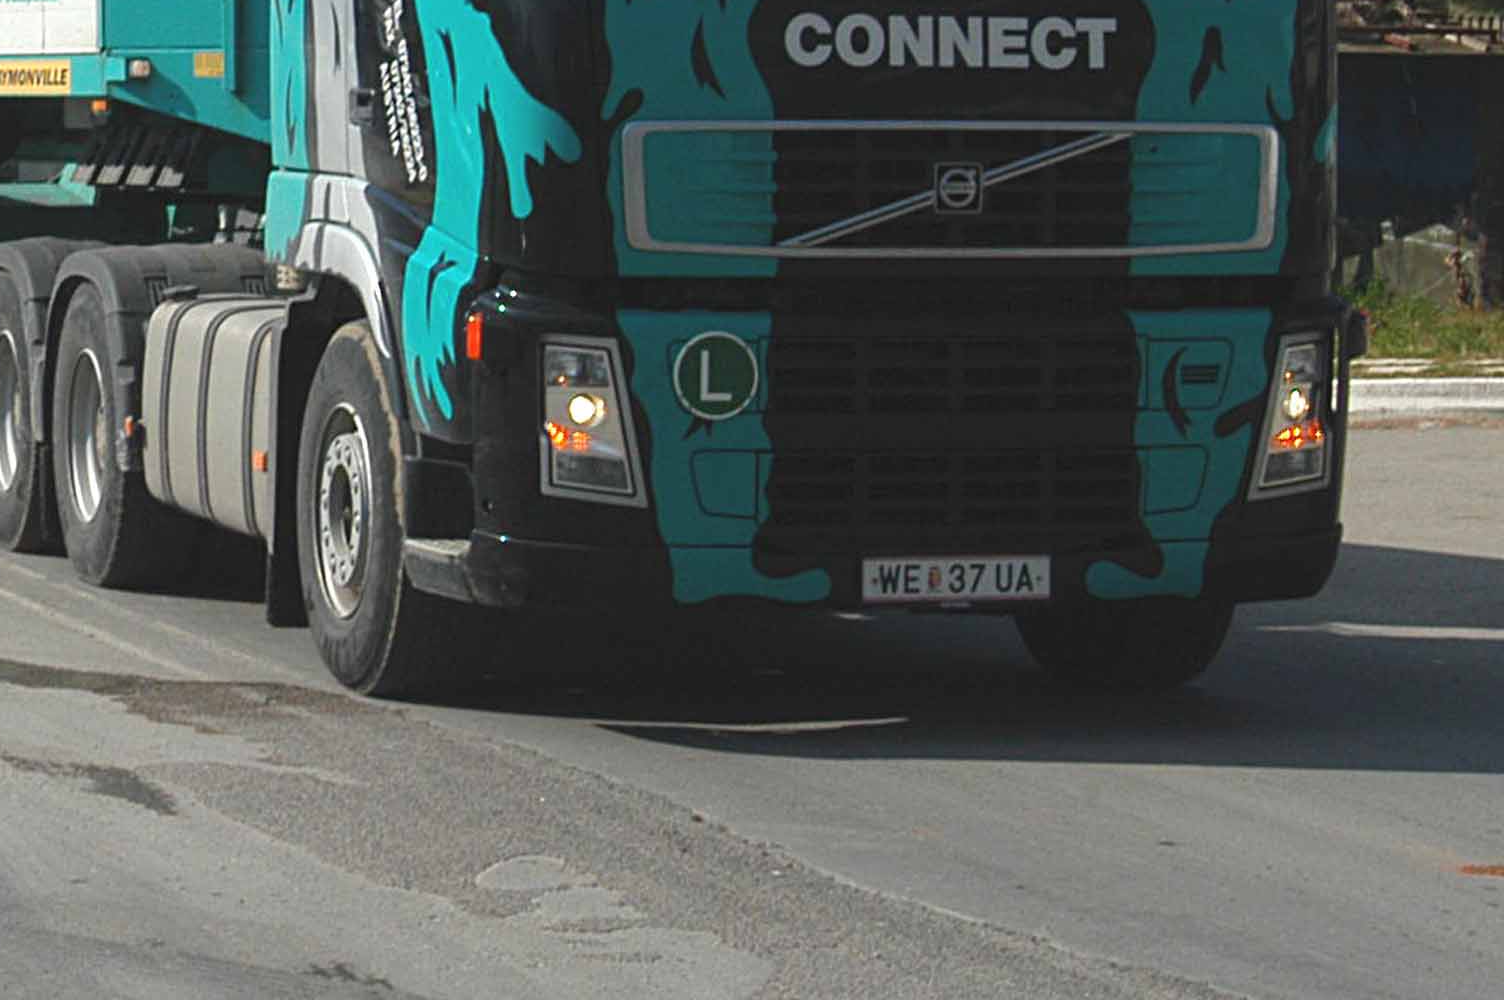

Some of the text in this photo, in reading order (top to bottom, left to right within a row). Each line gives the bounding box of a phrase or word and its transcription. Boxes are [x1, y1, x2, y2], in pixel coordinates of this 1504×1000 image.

[784, 12, 1117, 70] CONNECT
[380, 62, 401, 157] AUSTRIA
[700, 350, 733, 401] L
[878, 562, 1034, 594] WE 37 UA
